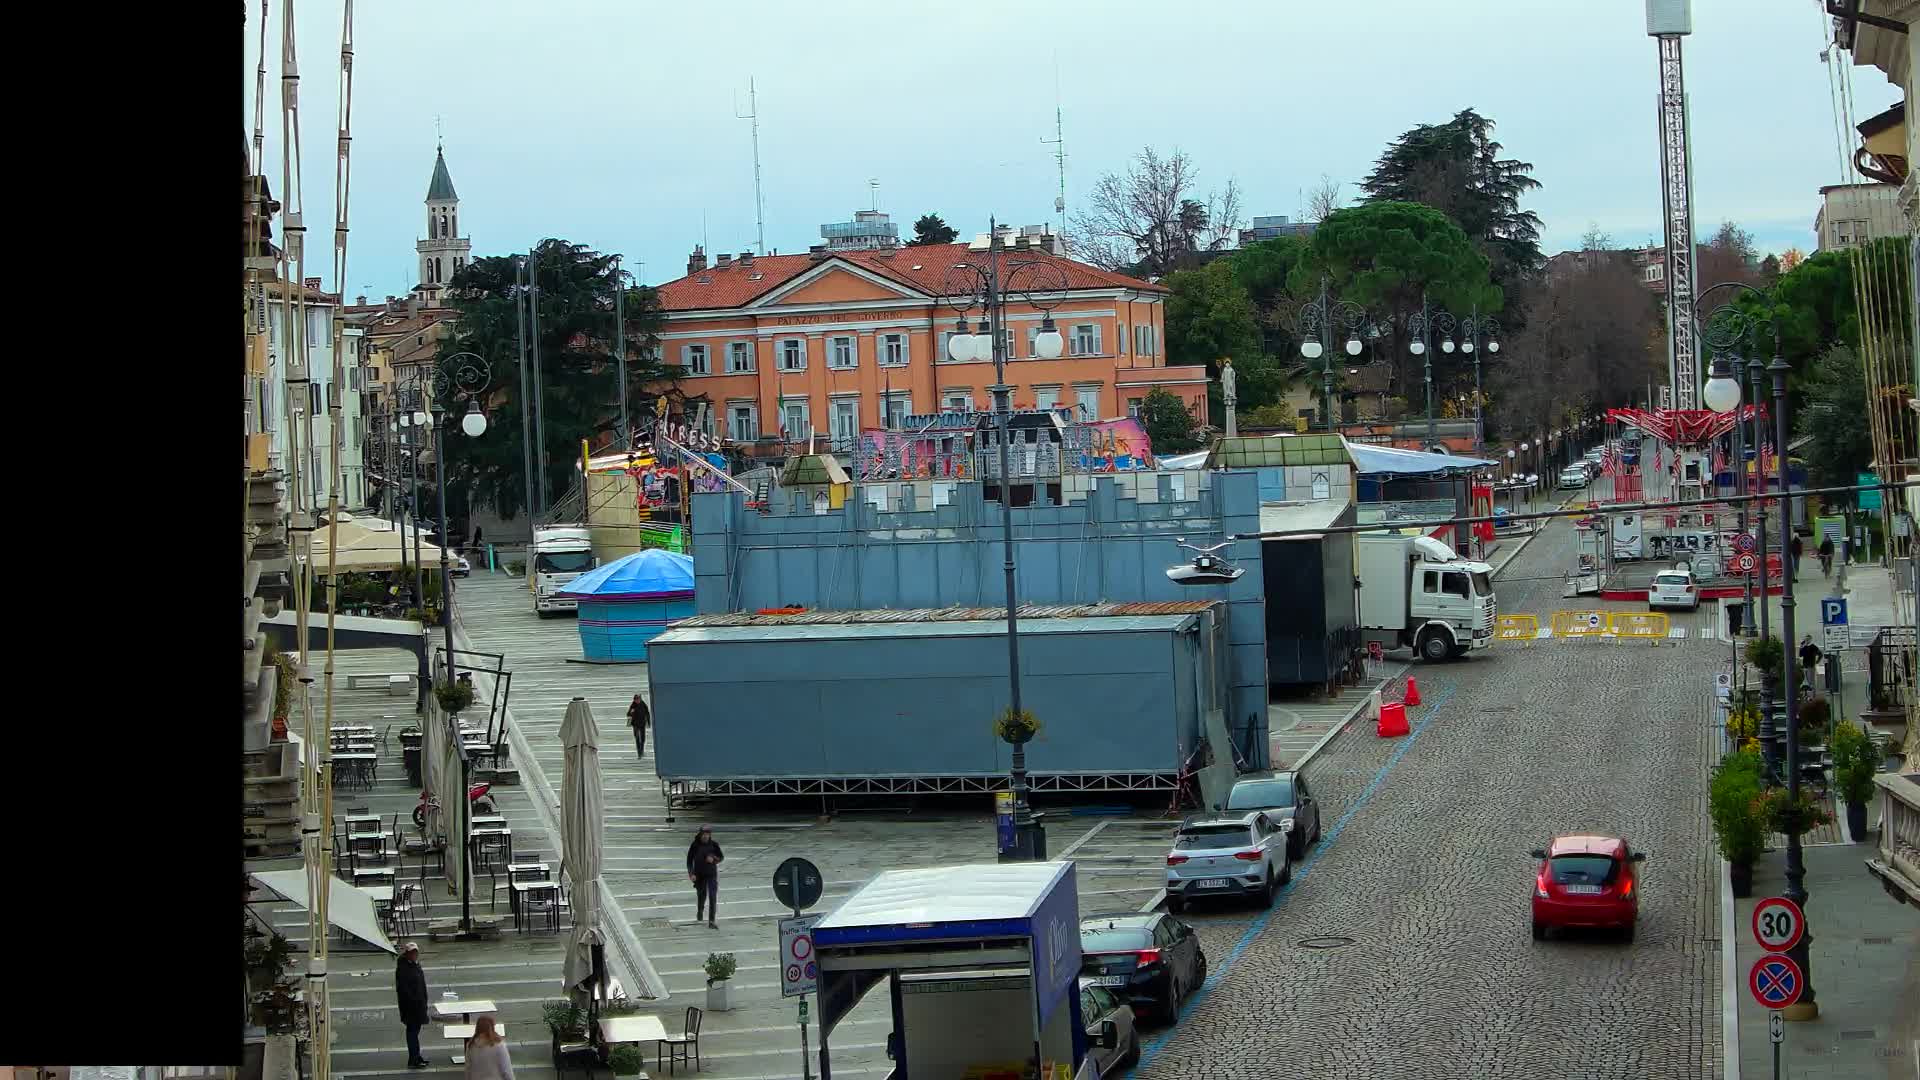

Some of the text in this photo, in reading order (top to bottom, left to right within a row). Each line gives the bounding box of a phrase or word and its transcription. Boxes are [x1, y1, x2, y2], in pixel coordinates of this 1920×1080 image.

[777, 315, 820, 326] PALAZZO
[1741, 558, 1752, 567] 20
[1827, 602, 1841, 622] P
[1762, 911, 1791, 938] 30
